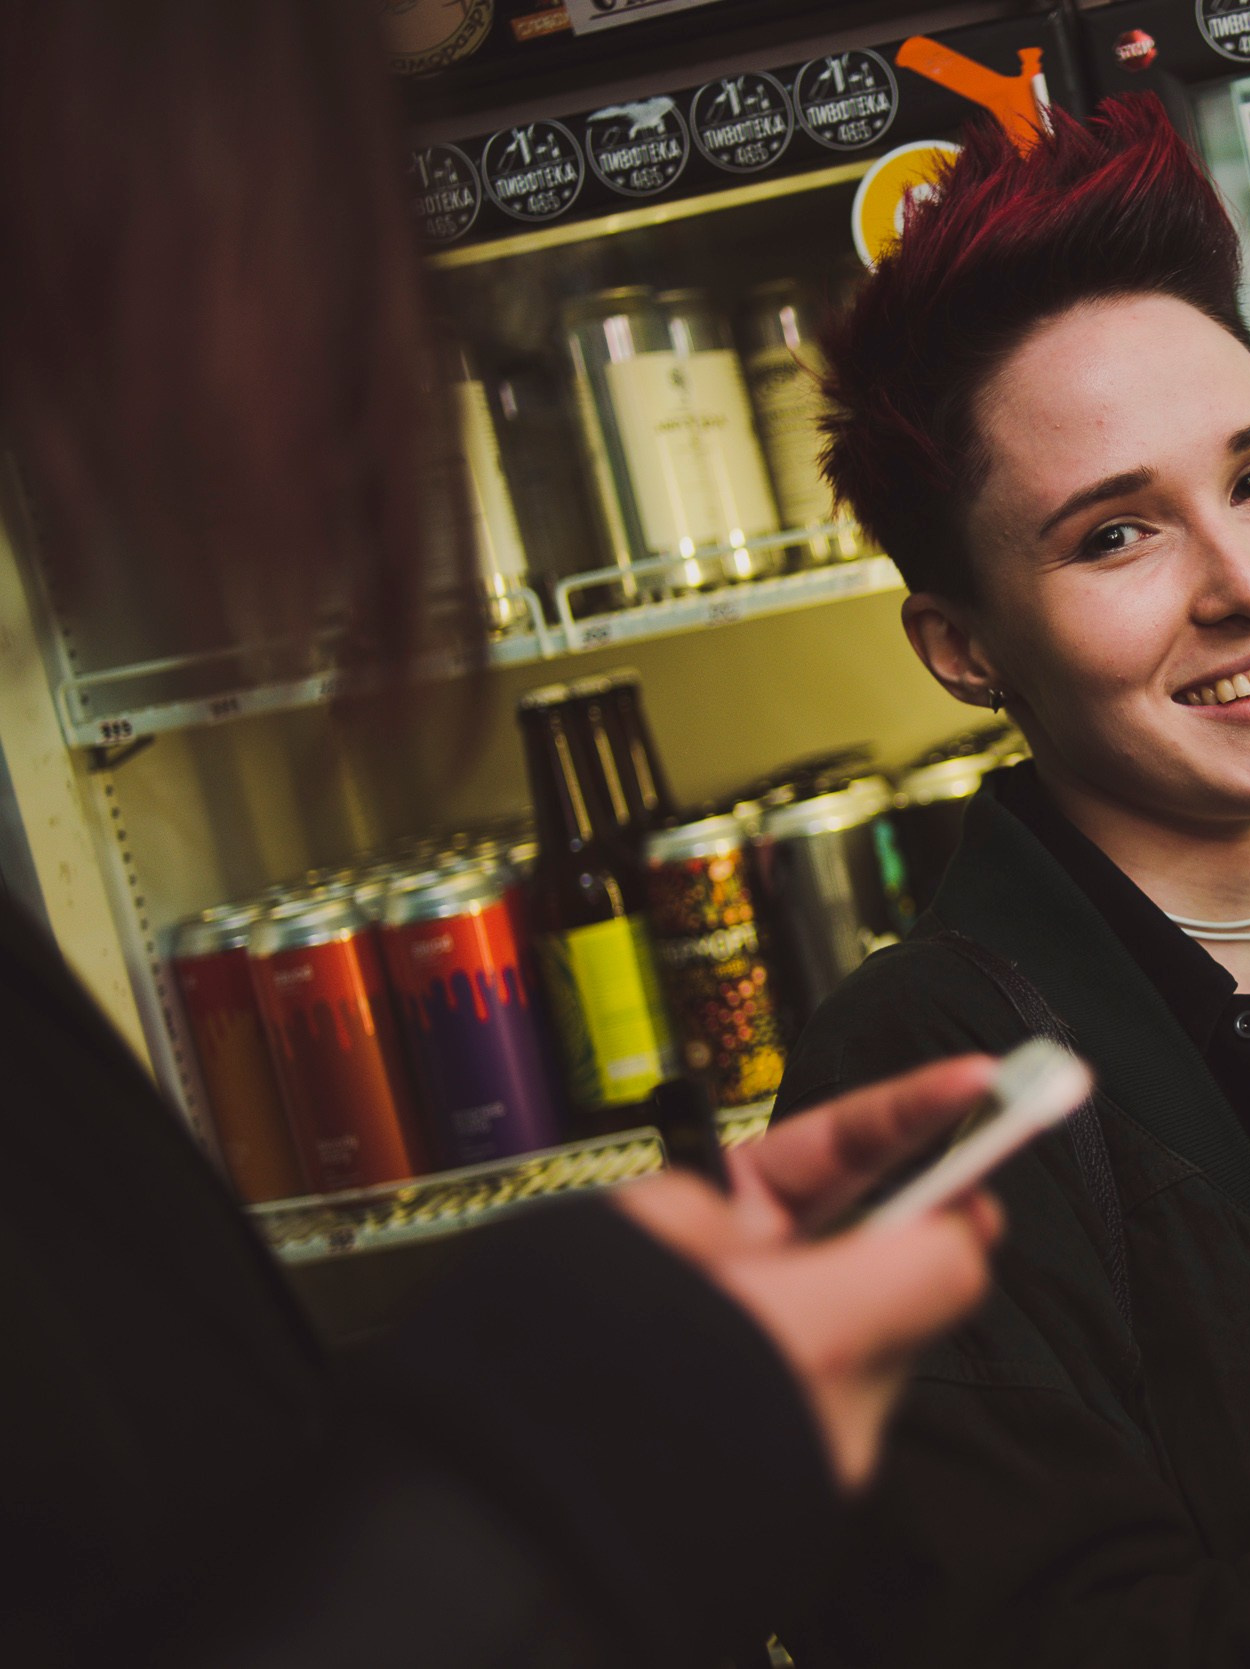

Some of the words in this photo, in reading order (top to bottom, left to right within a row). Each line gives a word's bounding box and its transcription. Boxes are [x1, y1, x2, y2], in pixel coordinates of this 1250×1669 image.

[806, 91, 892, 128] ПИВОТЕКА
[703, 113, 788, 151] ПИВОТЕКА
[598, 138, 683, 175] ПИВОТЕКА
[495, 161, 578, 200] ПИВОТЕКА
